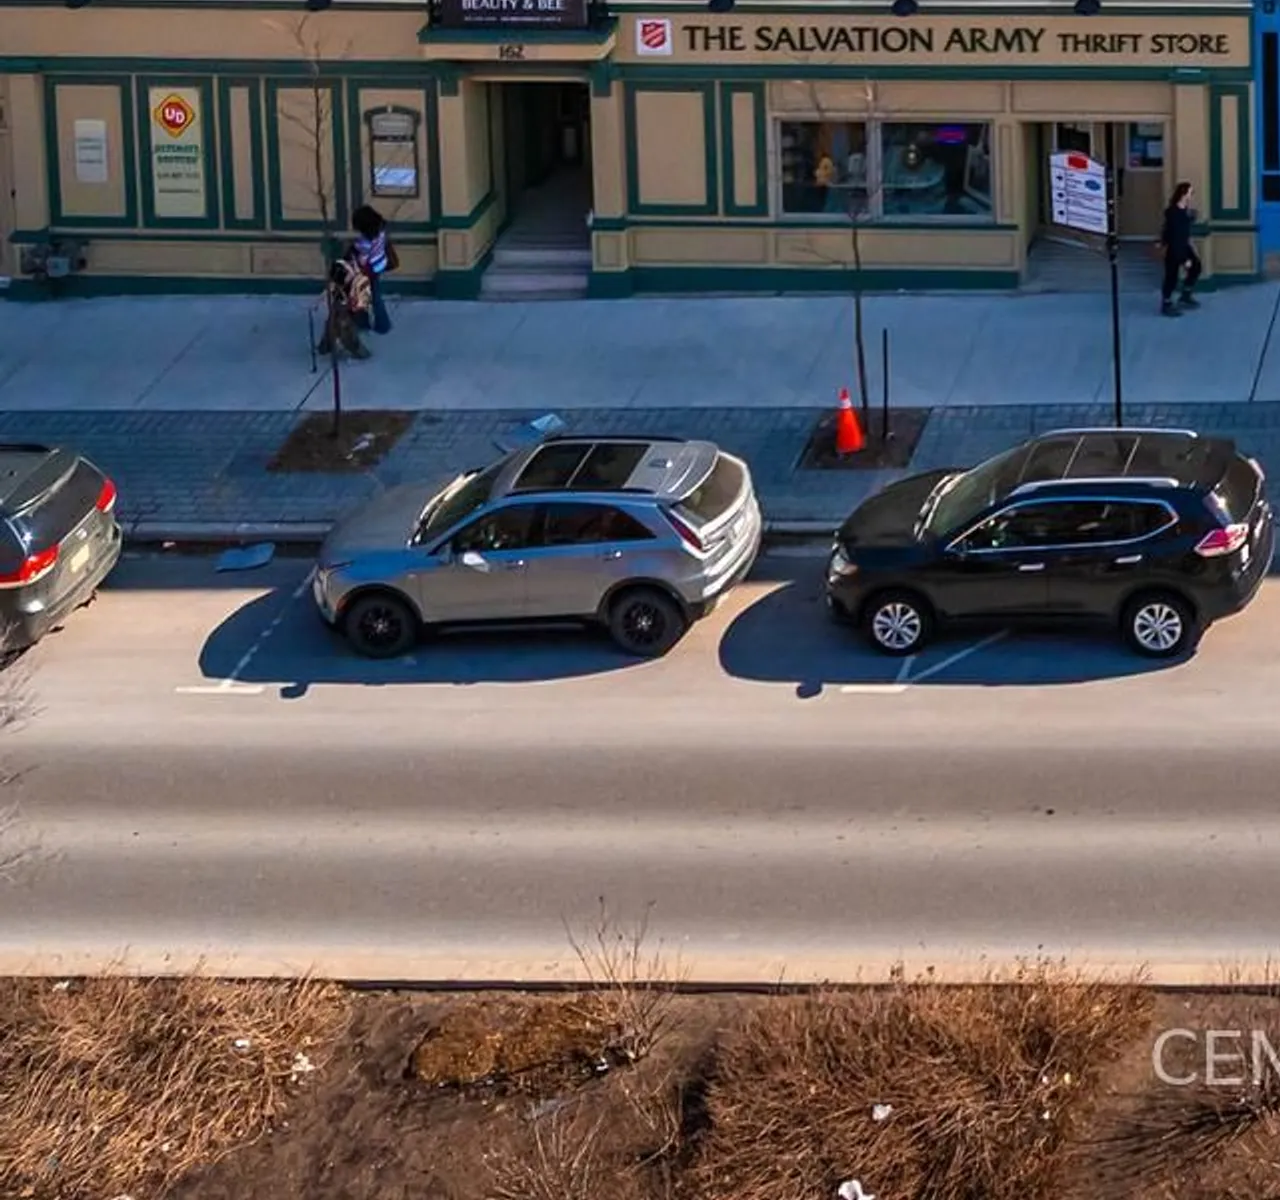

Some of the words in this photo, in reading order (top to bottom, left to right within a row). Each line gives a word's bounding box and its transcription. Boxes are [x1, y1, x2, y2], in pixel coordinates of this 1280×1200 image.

[682, 25, 746, 51] THE
[754, 25, 933, 53] SALVATION
[944, 27, 1045, 53] ARMY
[1057, 33, 1143, 54] THRIFT
[1150, 33, 1230, 55] STORE
